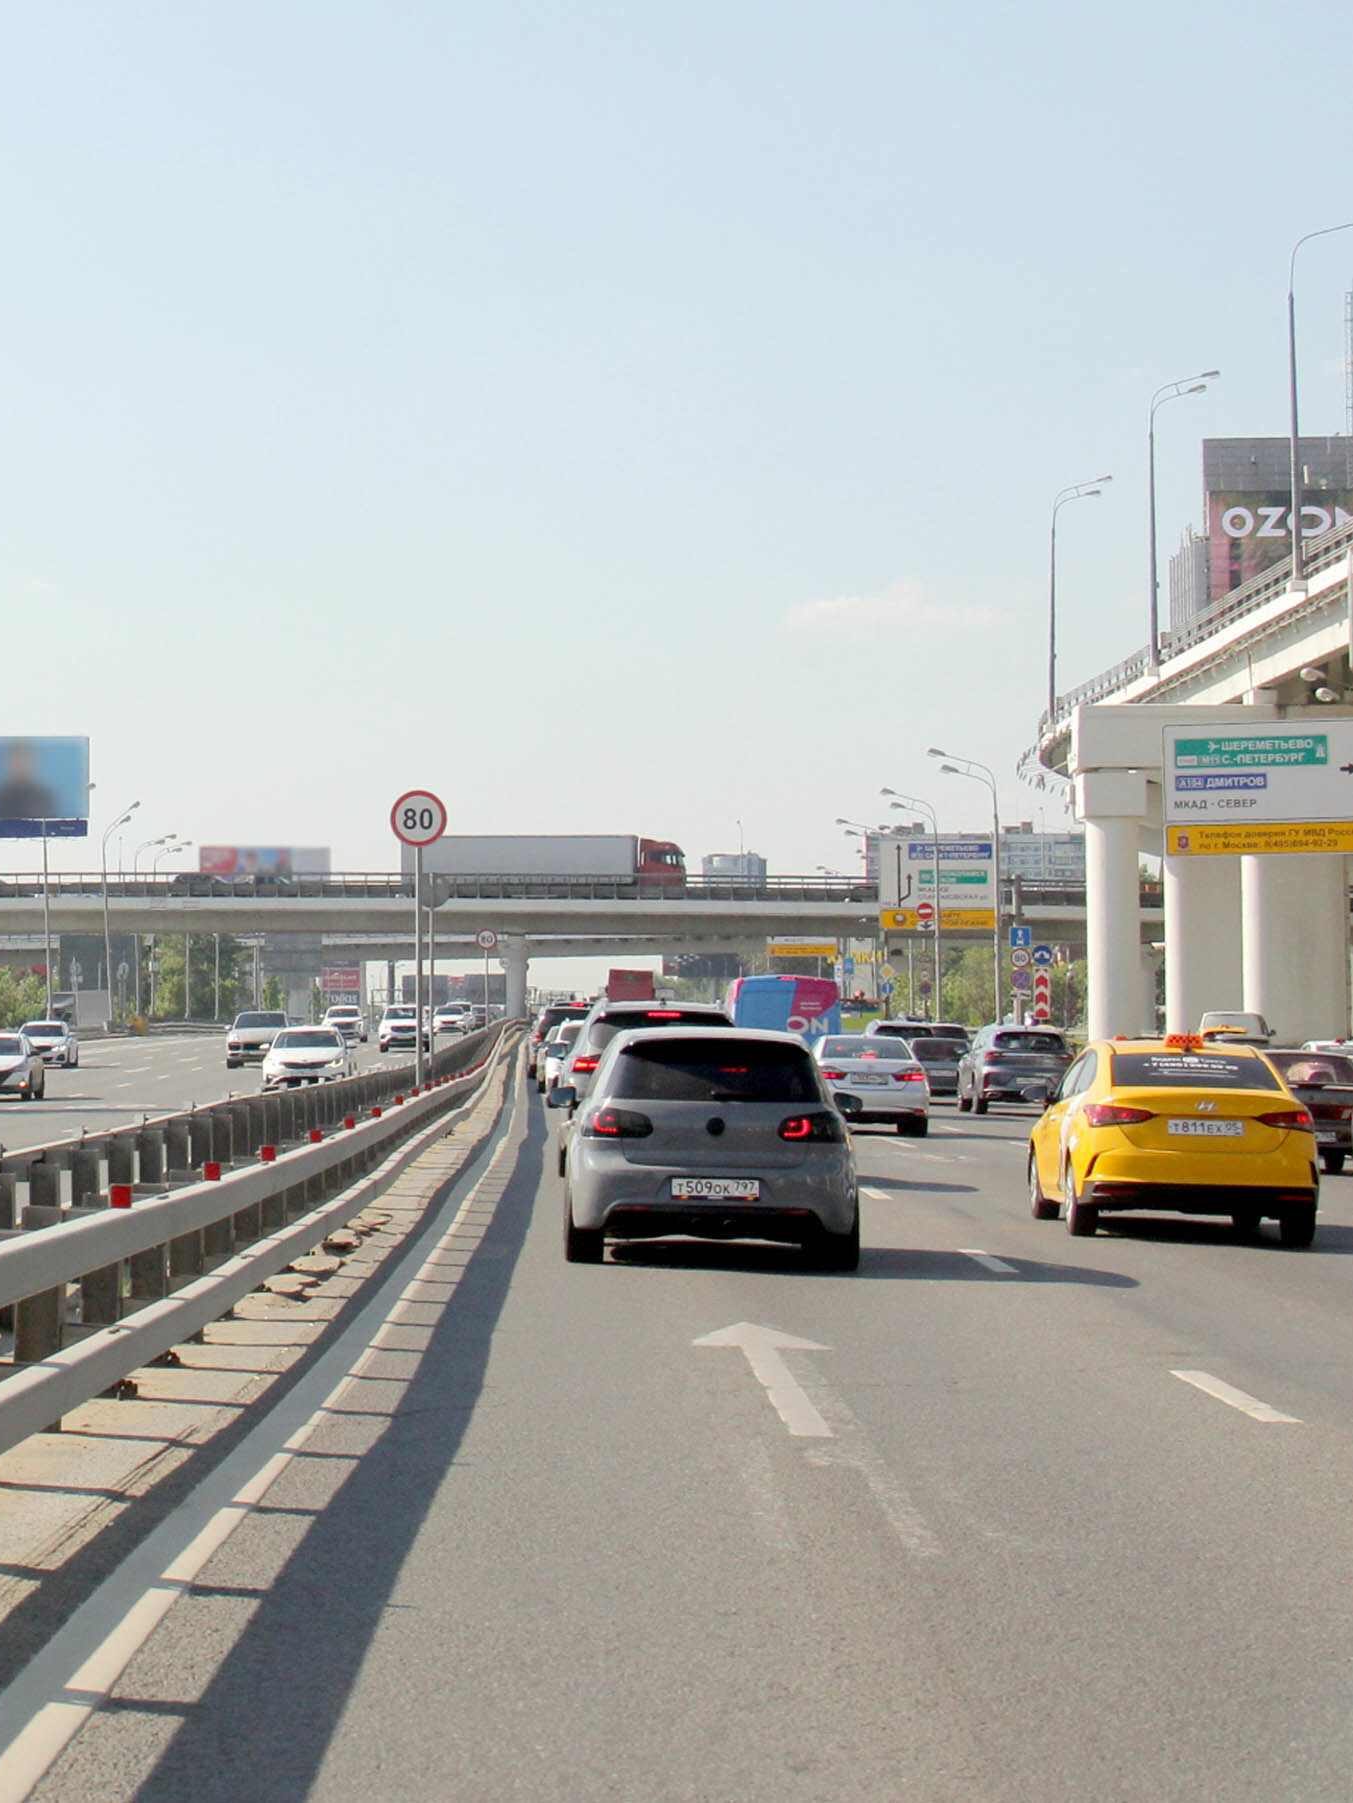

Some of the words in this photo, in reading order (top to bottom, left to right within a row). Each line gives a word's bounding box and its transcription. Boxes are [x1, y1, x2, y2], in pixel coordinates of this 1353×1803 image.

[1221, 739, 1313, 750] ШЕРЕМЕТЬЕВО
[1222, 753, 1305, 764] С.-ПЕТЕРБУРГ
[1206, 775, 1265, 788] ДМИТРОВ
[1174, 801, 1208, 809] МКАД
[1217, 799, 1257, 808] СЕВЕР
[403, 808, 433, 830] 80
[787, 1016, 829, 1035] ON
[677, 1180, 730, 1194] Т509ОК
[735, 1181, 755, 1192] 797
